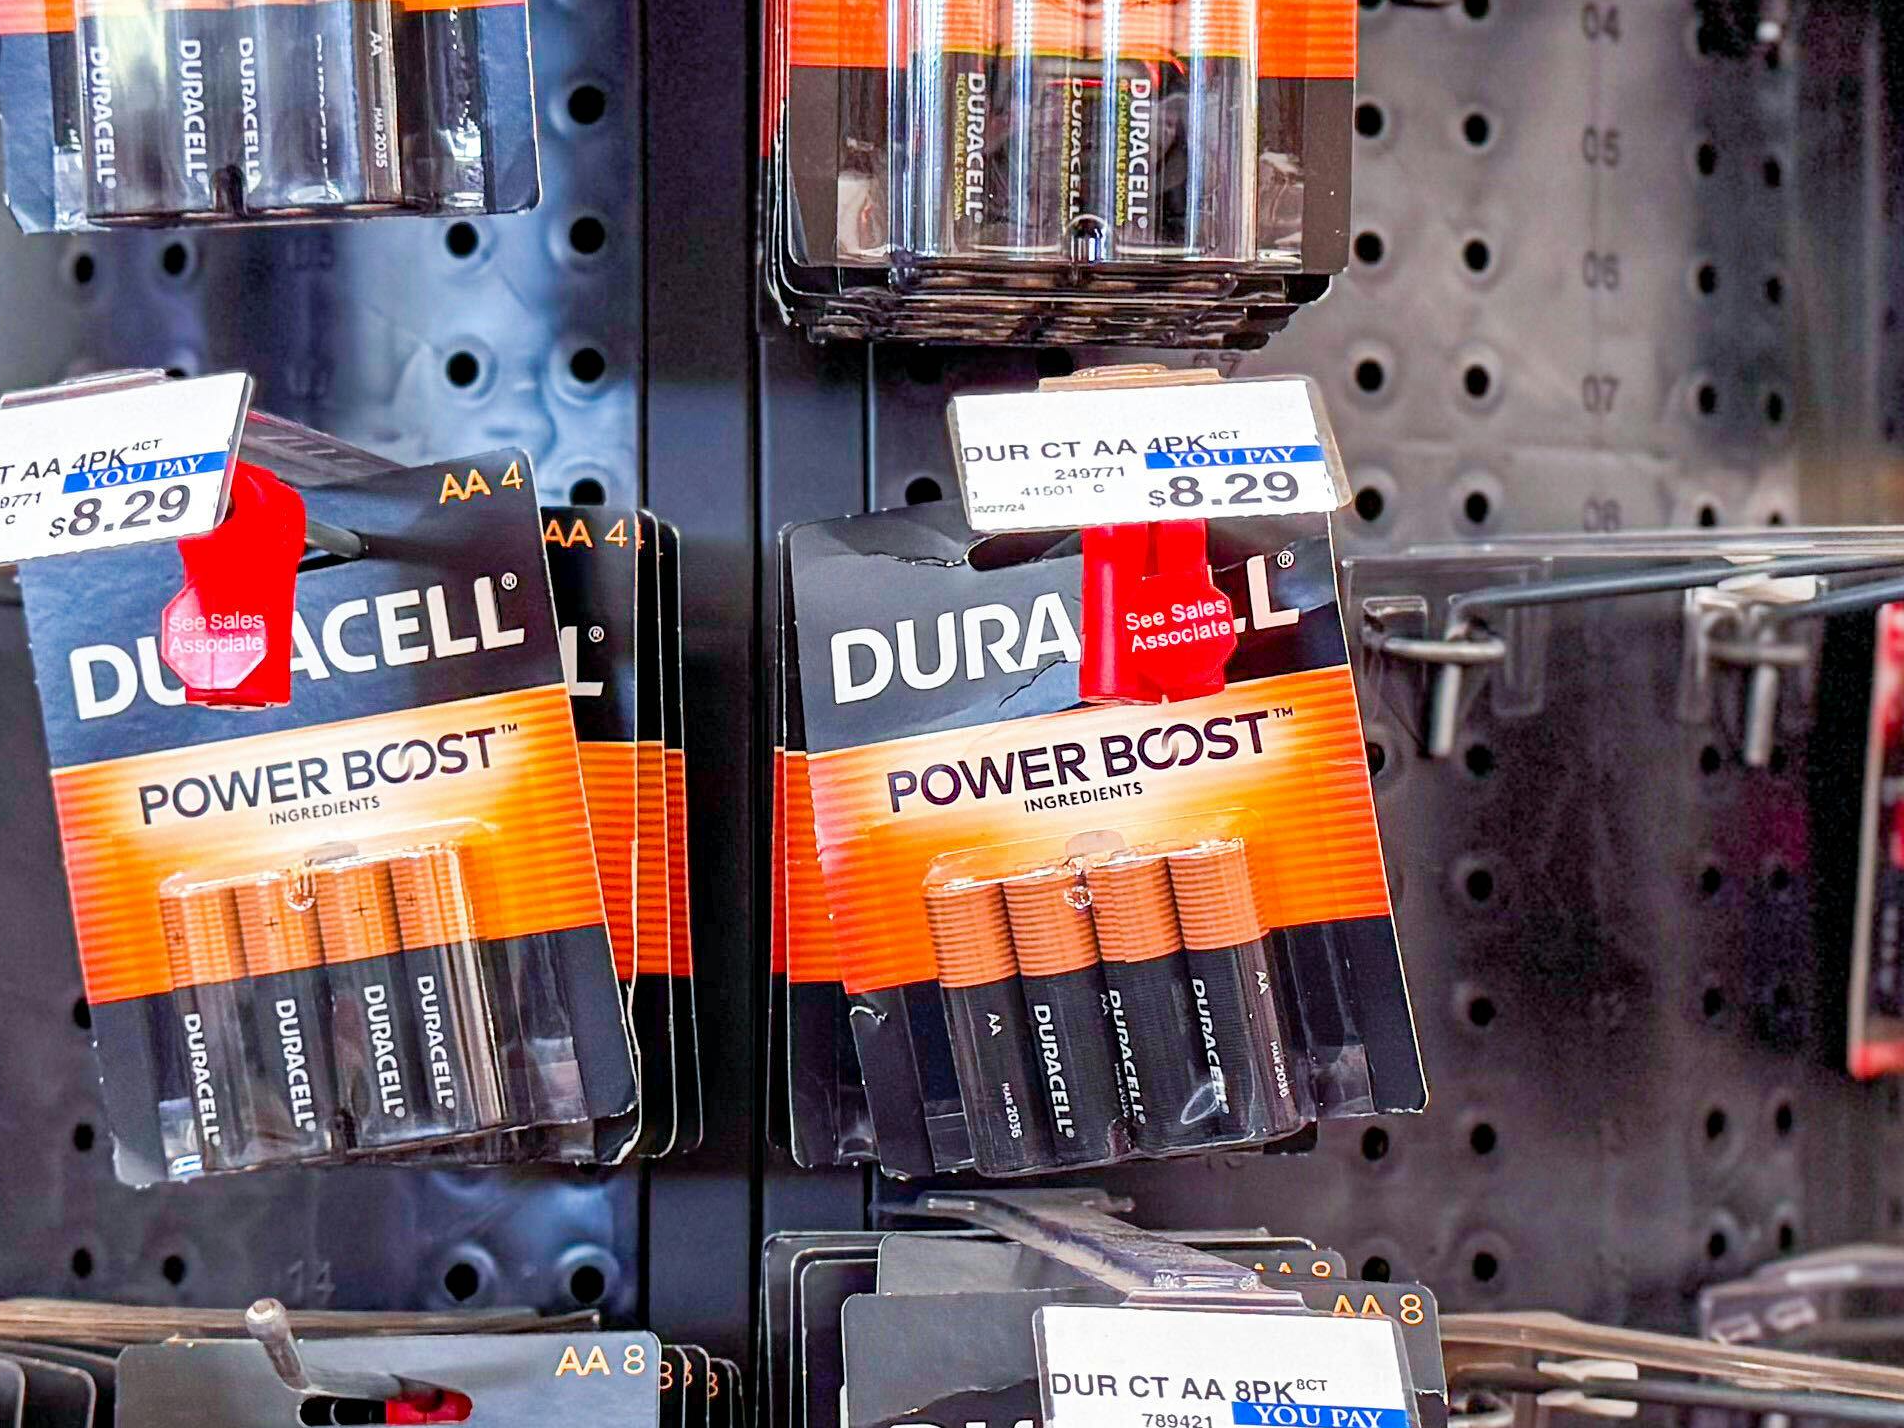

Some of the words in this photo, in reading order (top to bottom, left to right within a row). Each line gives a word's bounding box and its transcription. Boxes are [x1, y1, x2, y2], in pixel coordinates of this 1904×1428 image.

[20, 458, 61, 481] AA
[72, 445, 128, 472] 4PK
[963, 445, 1030, 462] DUR
[1041, 442, 1080, 459] CT
[1093, 440, 1137, 456] AA
[1147, 434, 1208, 452] 4PK
[439, 472, 491, 505] AA
[501, 462, 523, 490] 4
[1149, 471, 1300, 508] $8.29
[49, 484, 191, 539] $8.29
[606, 519, 627, 546] 4
[210, 611, 265, 630] Sales
[831, 553, 1301, 706] DURAL
[1126, 611, 1166, 632] See
[1171, 599, 1227, 624] Sales
[169, 633, 266, 655] Associate
[1131, 623, 1230, 653] Associate
[138, 755, 338, 825] POWER
[346, 727, 494, 789] BOOST
[888, 742, 1085, 814] POWER
[1103, 710, 1268, 776] BOOST
[269, 796, 380, 825] INGREDIENTS
[1024, 781, 1143, 813] INGREDIENTS
[1033, 1004, 1074, 1134] DURACELL
[1400, 1294, 1424, 1325] 8
[555, 1347, 610, 1376] AA
[623, 1345, 646, 1375] 8
[1051, 1373, 1117, 1397] DUR
[1129, 1376, 1169, 1399] CT
[1181, 1378, 1225, 1400] AA
[1236, 1380, 1296, 1404] 8PK
[1253, 1405, 1322, 1428] YOU
[1331, 1409, 1383, 1428] PAY
